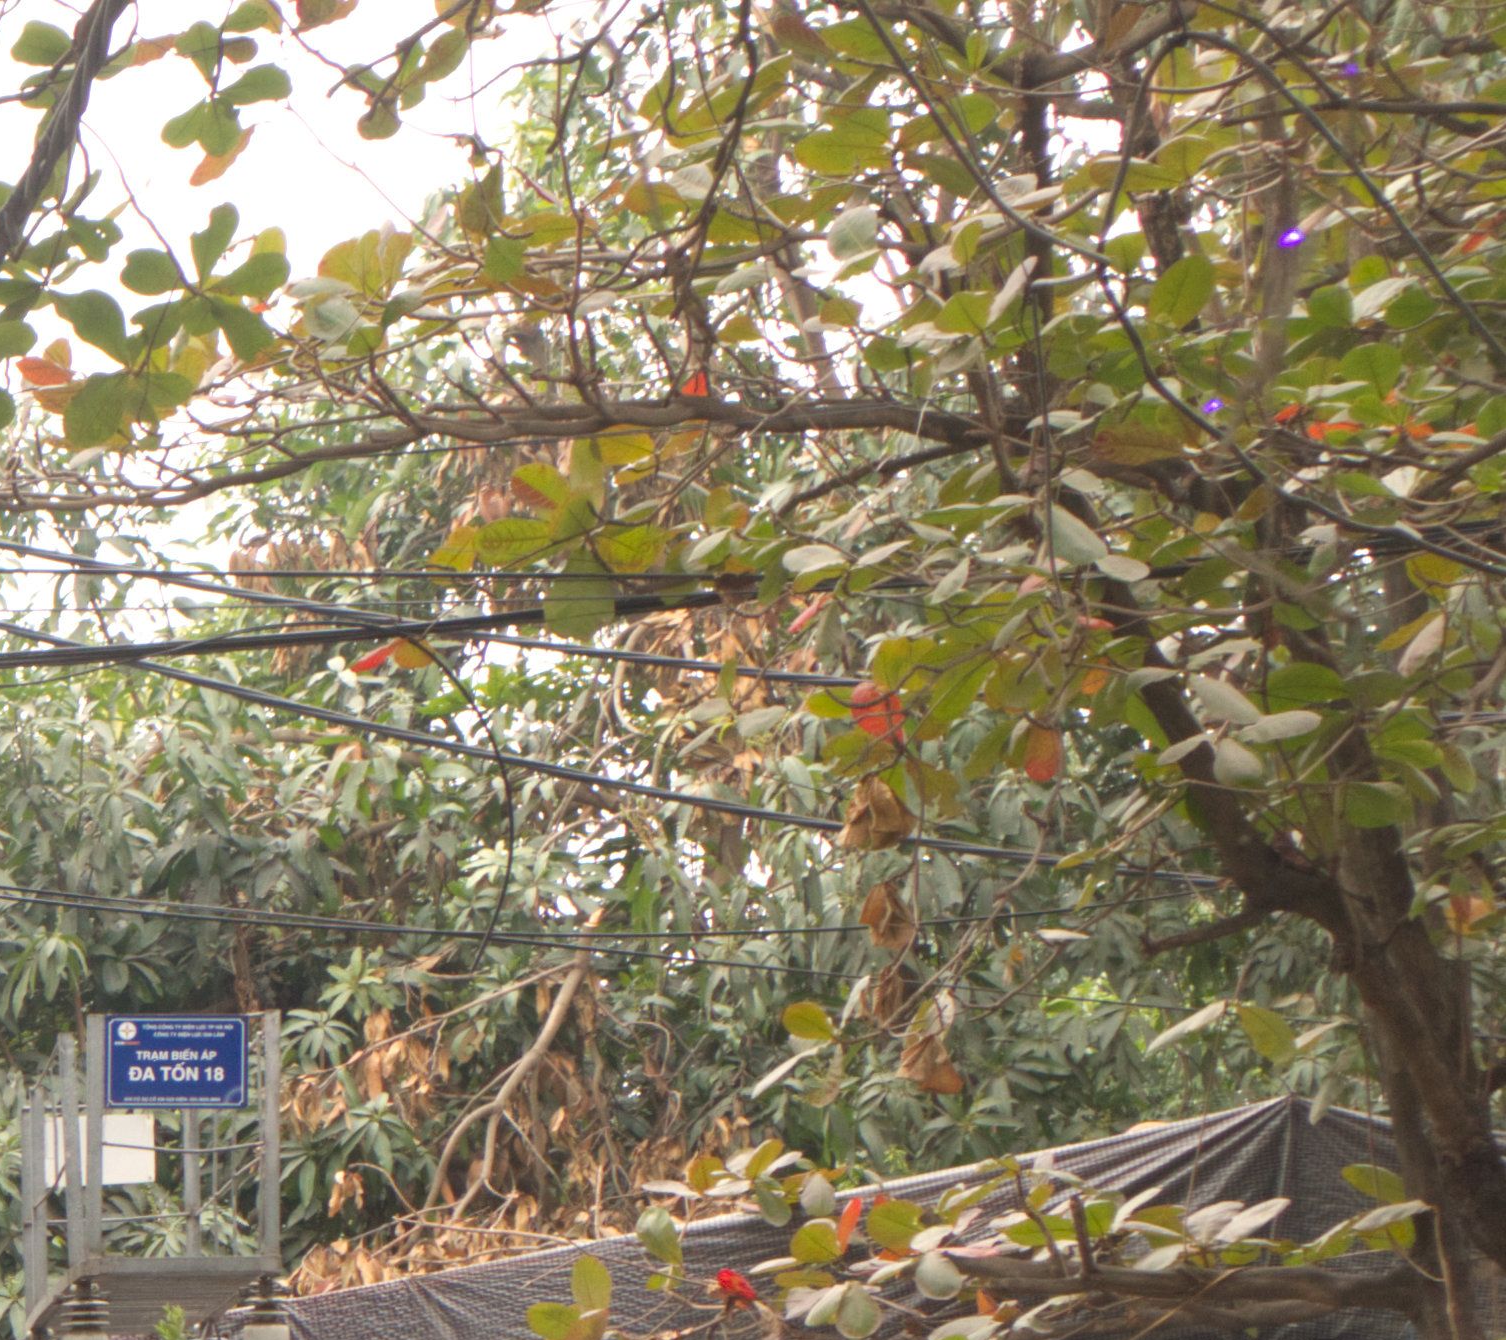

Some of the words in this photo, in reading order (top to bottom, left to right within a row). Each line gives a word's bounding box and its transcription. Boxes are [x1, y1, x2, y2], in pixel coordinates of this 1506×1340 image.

[135, 1050, 169, 1061] TRẠM
[171, 1048, 199, 1060] BIẾN
[200, 1049, 217, 1060] ÁP
[128, 1066, 155, 1081] ĐA
[160, 1062, 199, 1081] TỐN
[204, 1066, 225, 1081] 18
